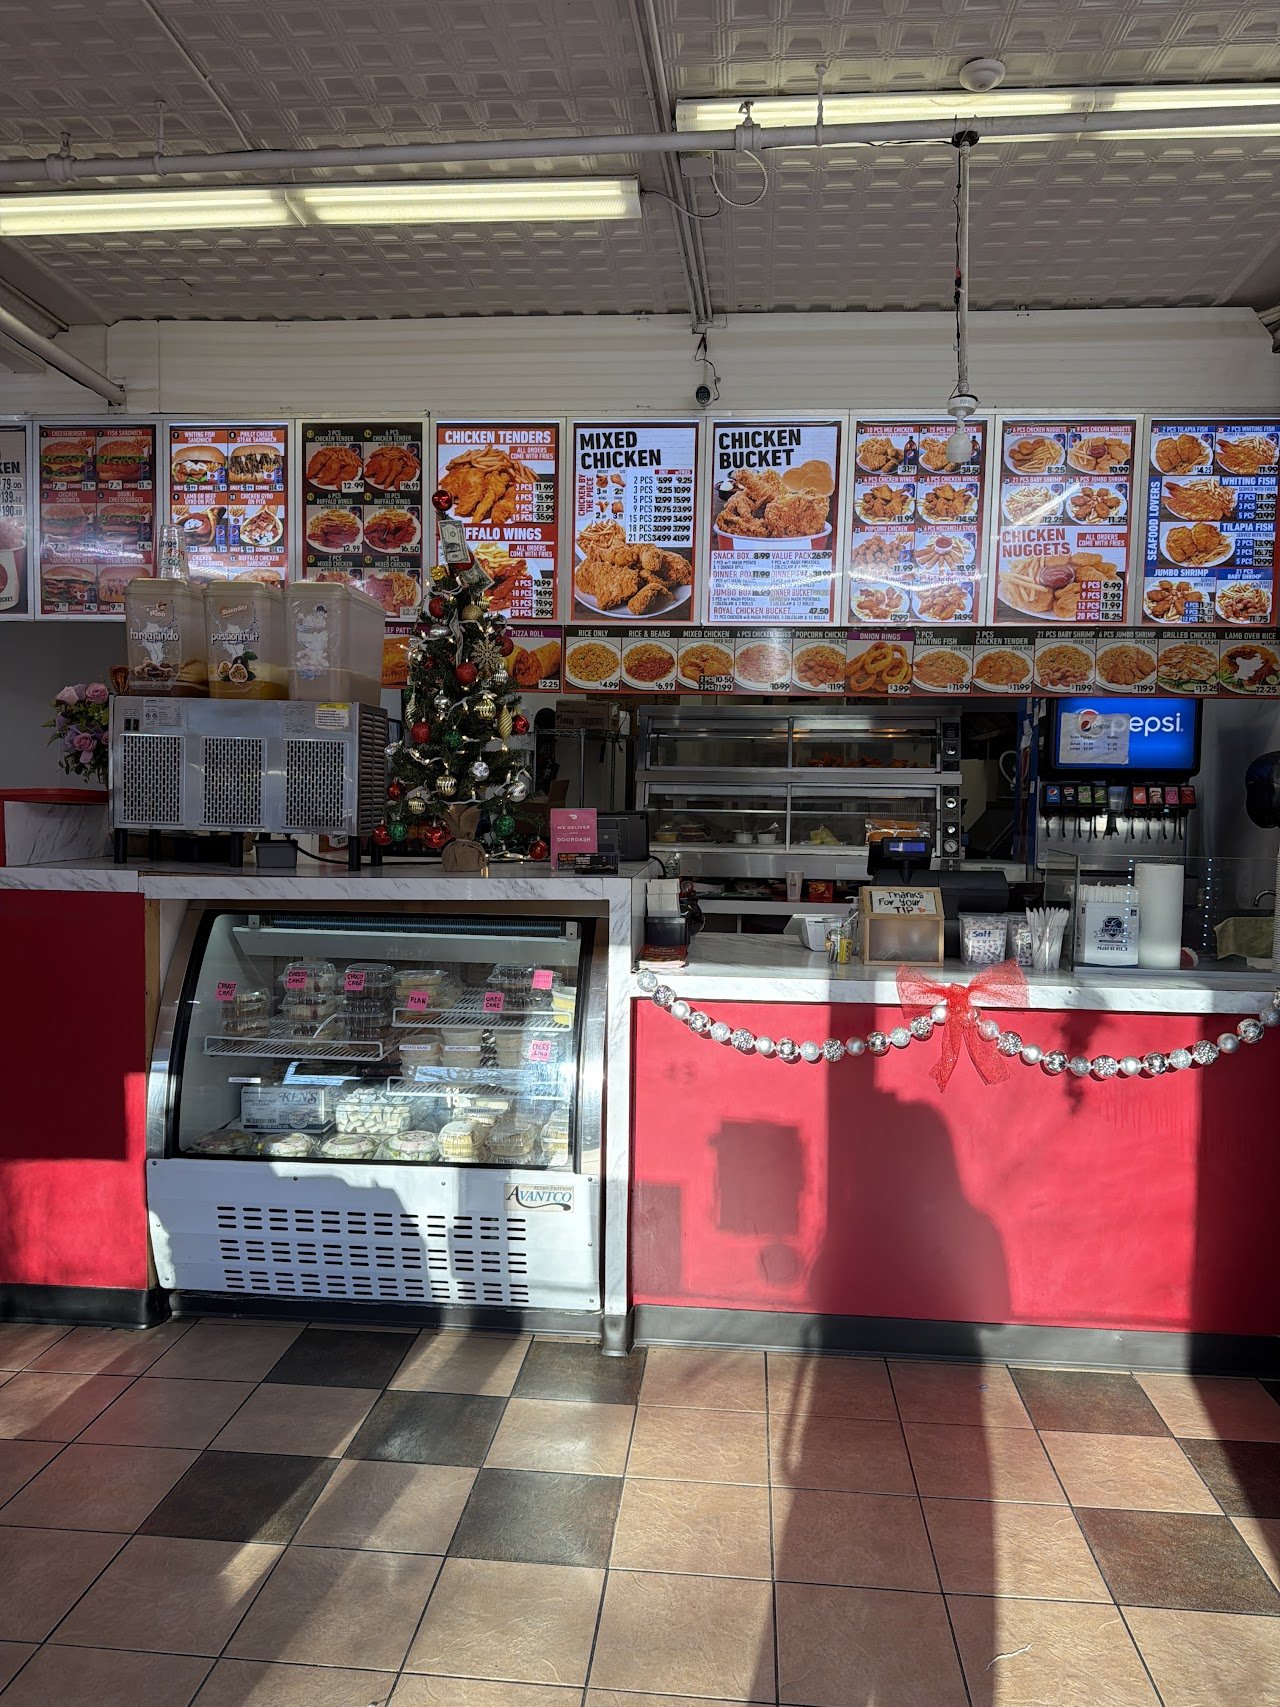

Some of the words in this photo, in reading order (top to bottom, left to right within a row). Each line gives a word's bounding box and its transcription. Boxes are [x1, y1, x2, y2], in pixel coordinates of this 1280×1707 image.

[445, 430, 495, 444] CHICKEN
[498, 430, 552, 444] TENDERS
[580, 431, 637, 450] MIXED
[719, 429, 801, 450] CHICKEN
[581, 449, 661, 469] CHICKEN
[720, 448, 795, 470] BUCKET
[578, 474, 585, 484] BY
[1221, 477, 1257, 485] WHITING
[1258, 477, 1276, 485] FISH
[1149, 481, 1161, 514] LOVERS
[633, 506, 638, 514] 9
[640, 506, 653, 514] PCS
[654, 506, 671, 514] 19.75
[672, 506, 692, 514] 23.99
[1222, 523, 1254, 532] TILAPIA
[1255, 523, 1273, 532] FISH
[465, 528, 500, 540] FFALO
[503, 528, 542, 540] WINGS
[1002, 528, 1065, 544] CHICKEN
[1147, 516, 1159, 561] SEAFOOD
[1002, 542, 1070, 558] NUGGETS
[713, 552, 735, 560] SNACK
[753, 552, 770, 560] 8.99
[1154, 569, 1179, 577] JUMBO
[1180, 569, 1209, 577] SHRIMP
[1103, 581, 1122, 590] 6.99
[1087, 591, 1100, 599] PCS
[1102, 591, 1121, 599] 8.99
[1101, 601, 1120, 609] 11.99
[713, 607, 733, 615] ROYAL
[735, 607, 764, 615] CHICKEN
[1077, 612, 1086, 620] 20
[1086, 612, 1099, 620] PCS
[130, 628, 179, 642] tamarindo
[210, 630, 259, 643] passionfruit
[683, 630, 702, 638] MIXED
[703, 630, 730, 638] CHICKEN
[860, 632, 880, 640] ONION
[881, 632, 901, 640] RINGS
[1162, 631, 1187, 639] GRILLED
[1189, 631, 1216, 639] CHICKEN
[1224, 632, 1241, 640] LAMB
[1243, 632, 1260, 640] OVER
[1262, 632, 1276, 640] RICE
[655, 682, 674, 690] $6.99
[1111, 712, 1181, 737] pepsi
[878, 897, 894, 906] For
[899, 898, 921, 906] your
[894, 906, 914, 914] TIP
[971, 929, 992, 938] Salt
[410, 996, 427, 1005] FLAN
[279, 1090, 318, 1105] KEN'S
[505, 1185, 572, 1206] AVANTCO
